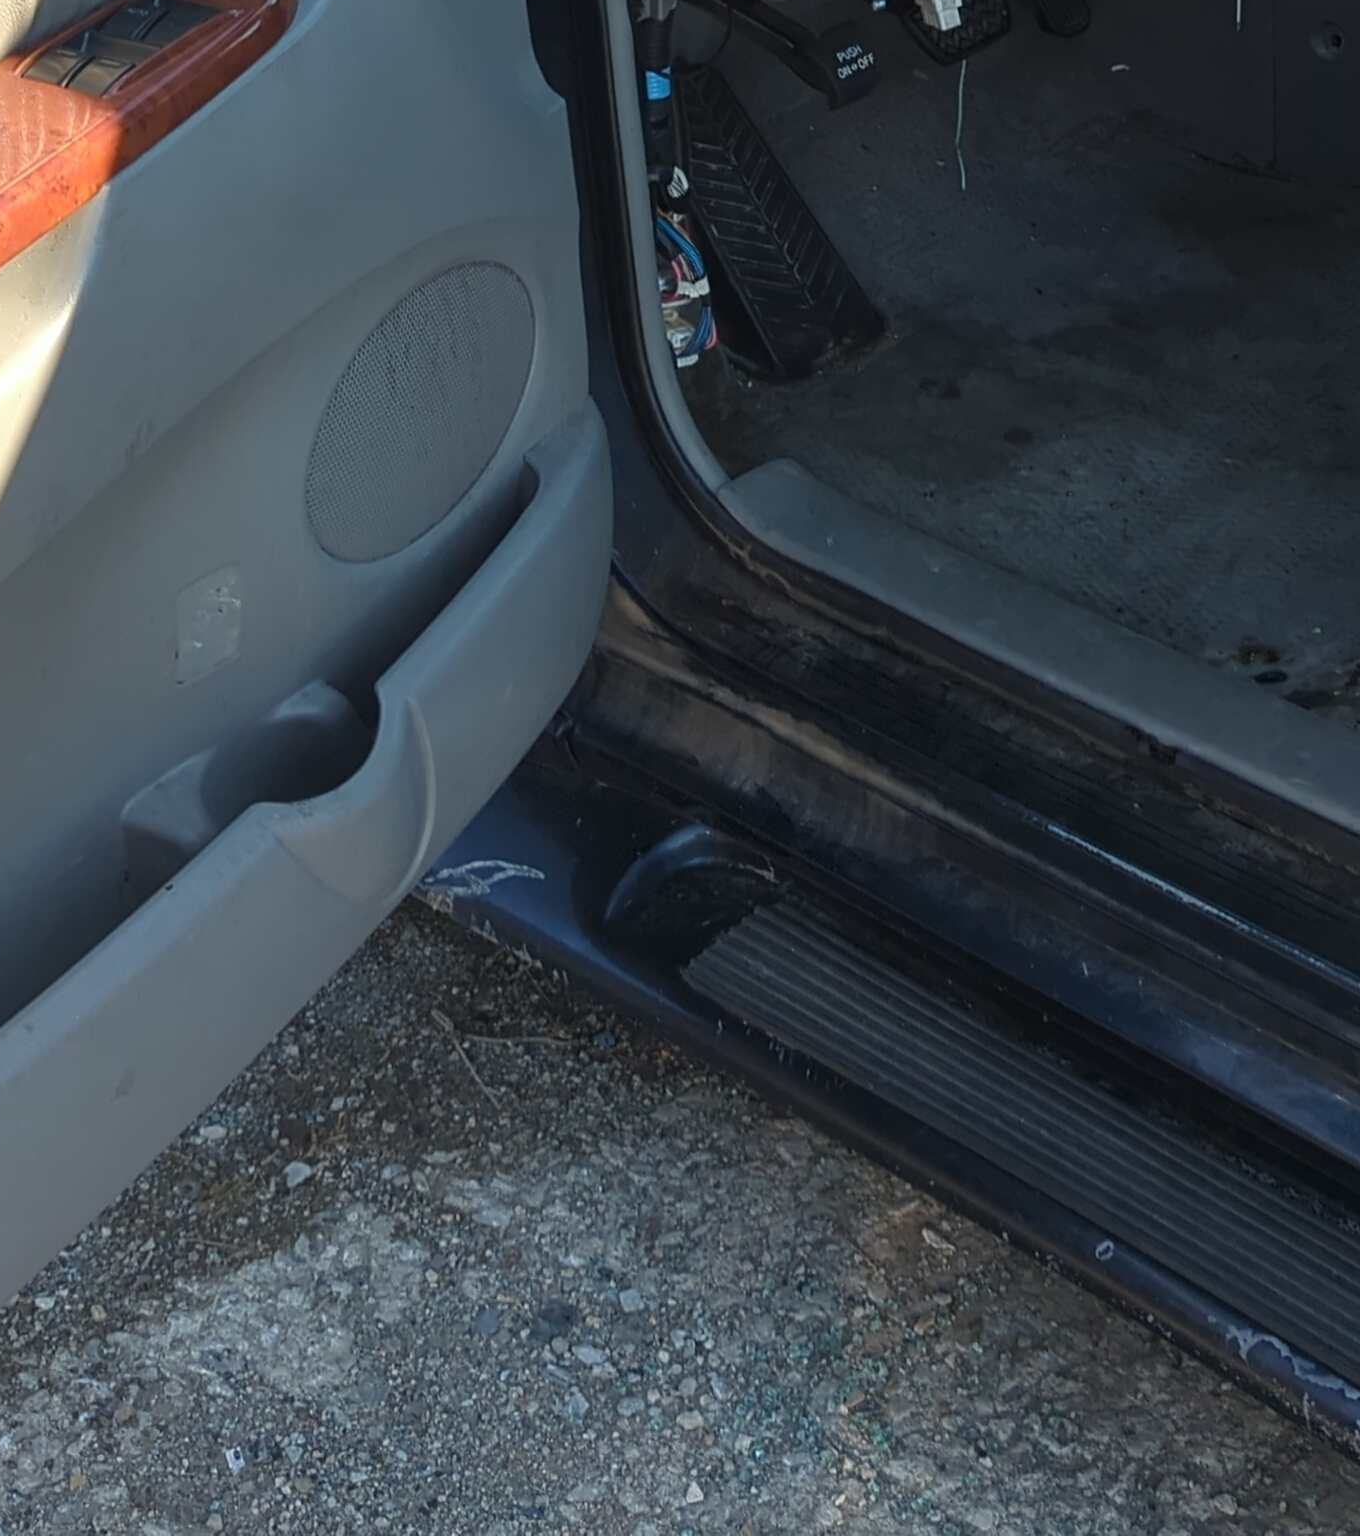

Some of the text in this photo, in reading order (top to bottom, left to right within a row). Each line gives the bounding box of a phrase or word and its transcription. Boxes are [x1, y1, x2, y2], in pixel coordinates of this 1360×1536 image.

[836, 44, 863, 63] PUSH
[837, 52, 874, 79] ON OFF
